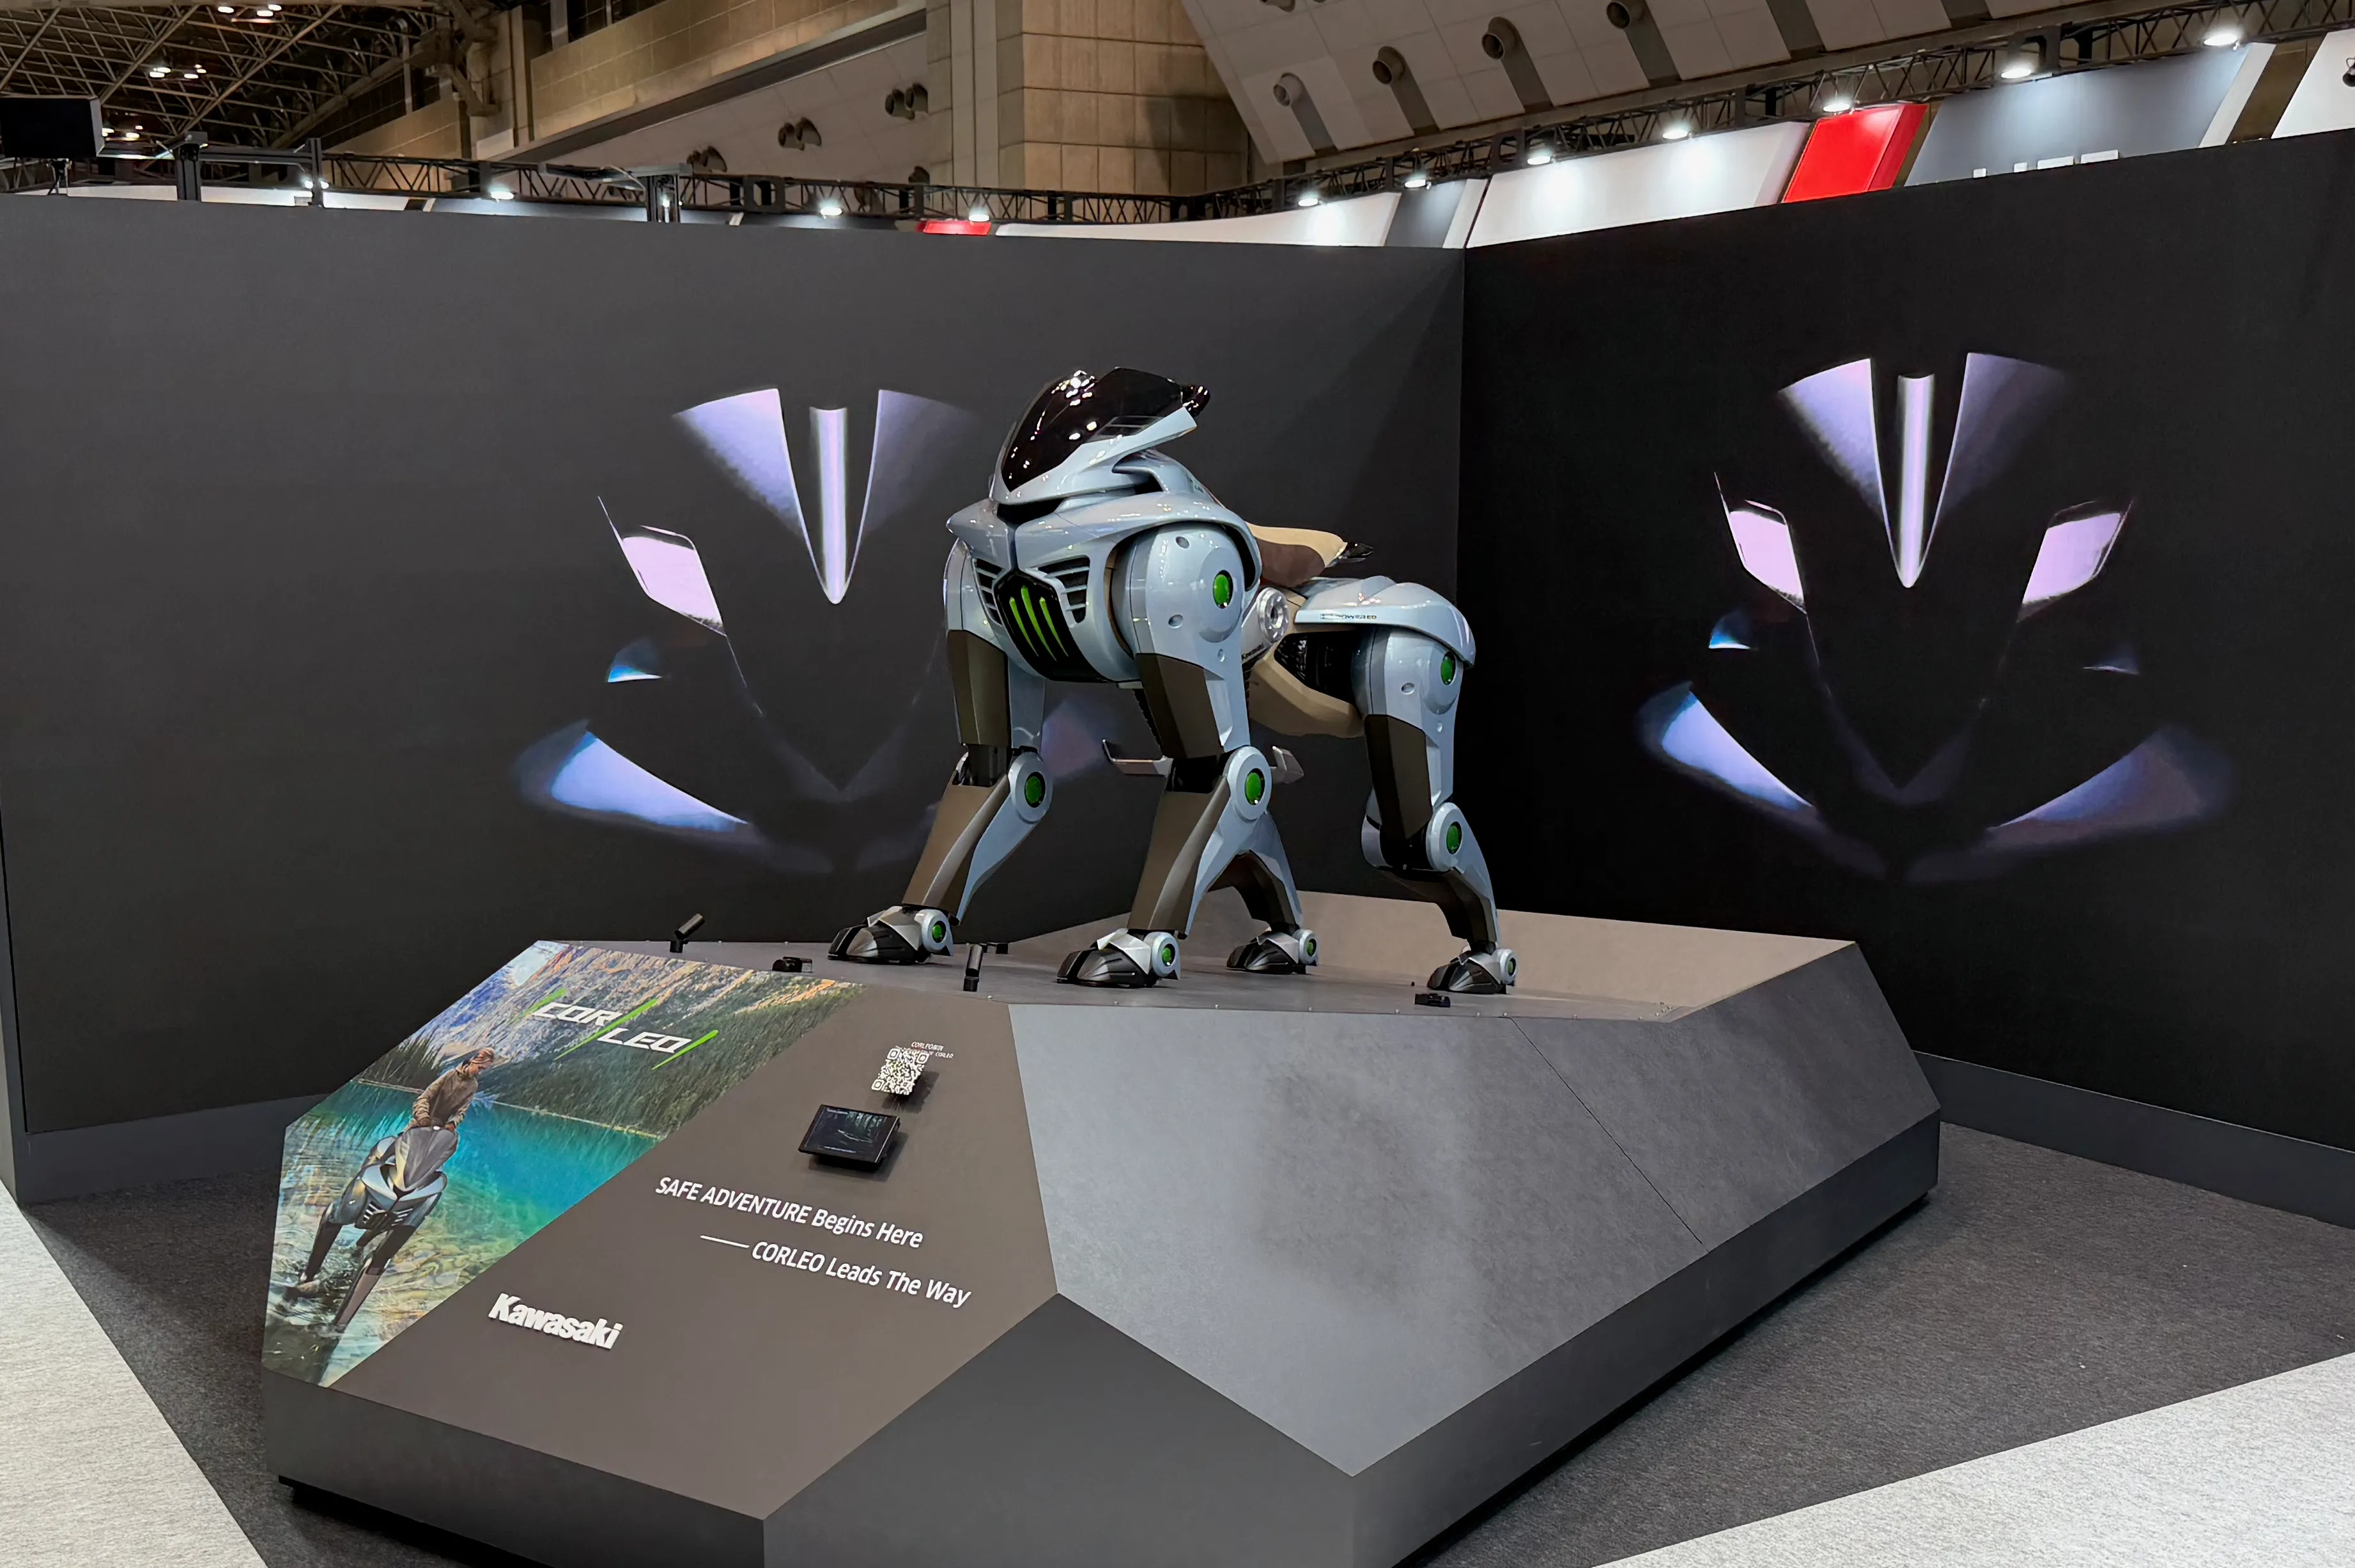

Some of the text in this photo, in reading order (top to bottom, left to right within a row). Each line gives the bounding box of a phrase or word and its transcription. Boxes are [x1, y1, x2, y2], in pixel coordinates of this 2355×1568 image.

[532, 1001, 622, 1026] COR
[597, 1027, 692, 1054] LEO
[655, 1177, 924, 1248] SAFE ADVENTURE Begins Here
[752, 1241, 972, 1309] CORLEO Leads The Way
[488, 1293, 623, 1349] Kawasaki
